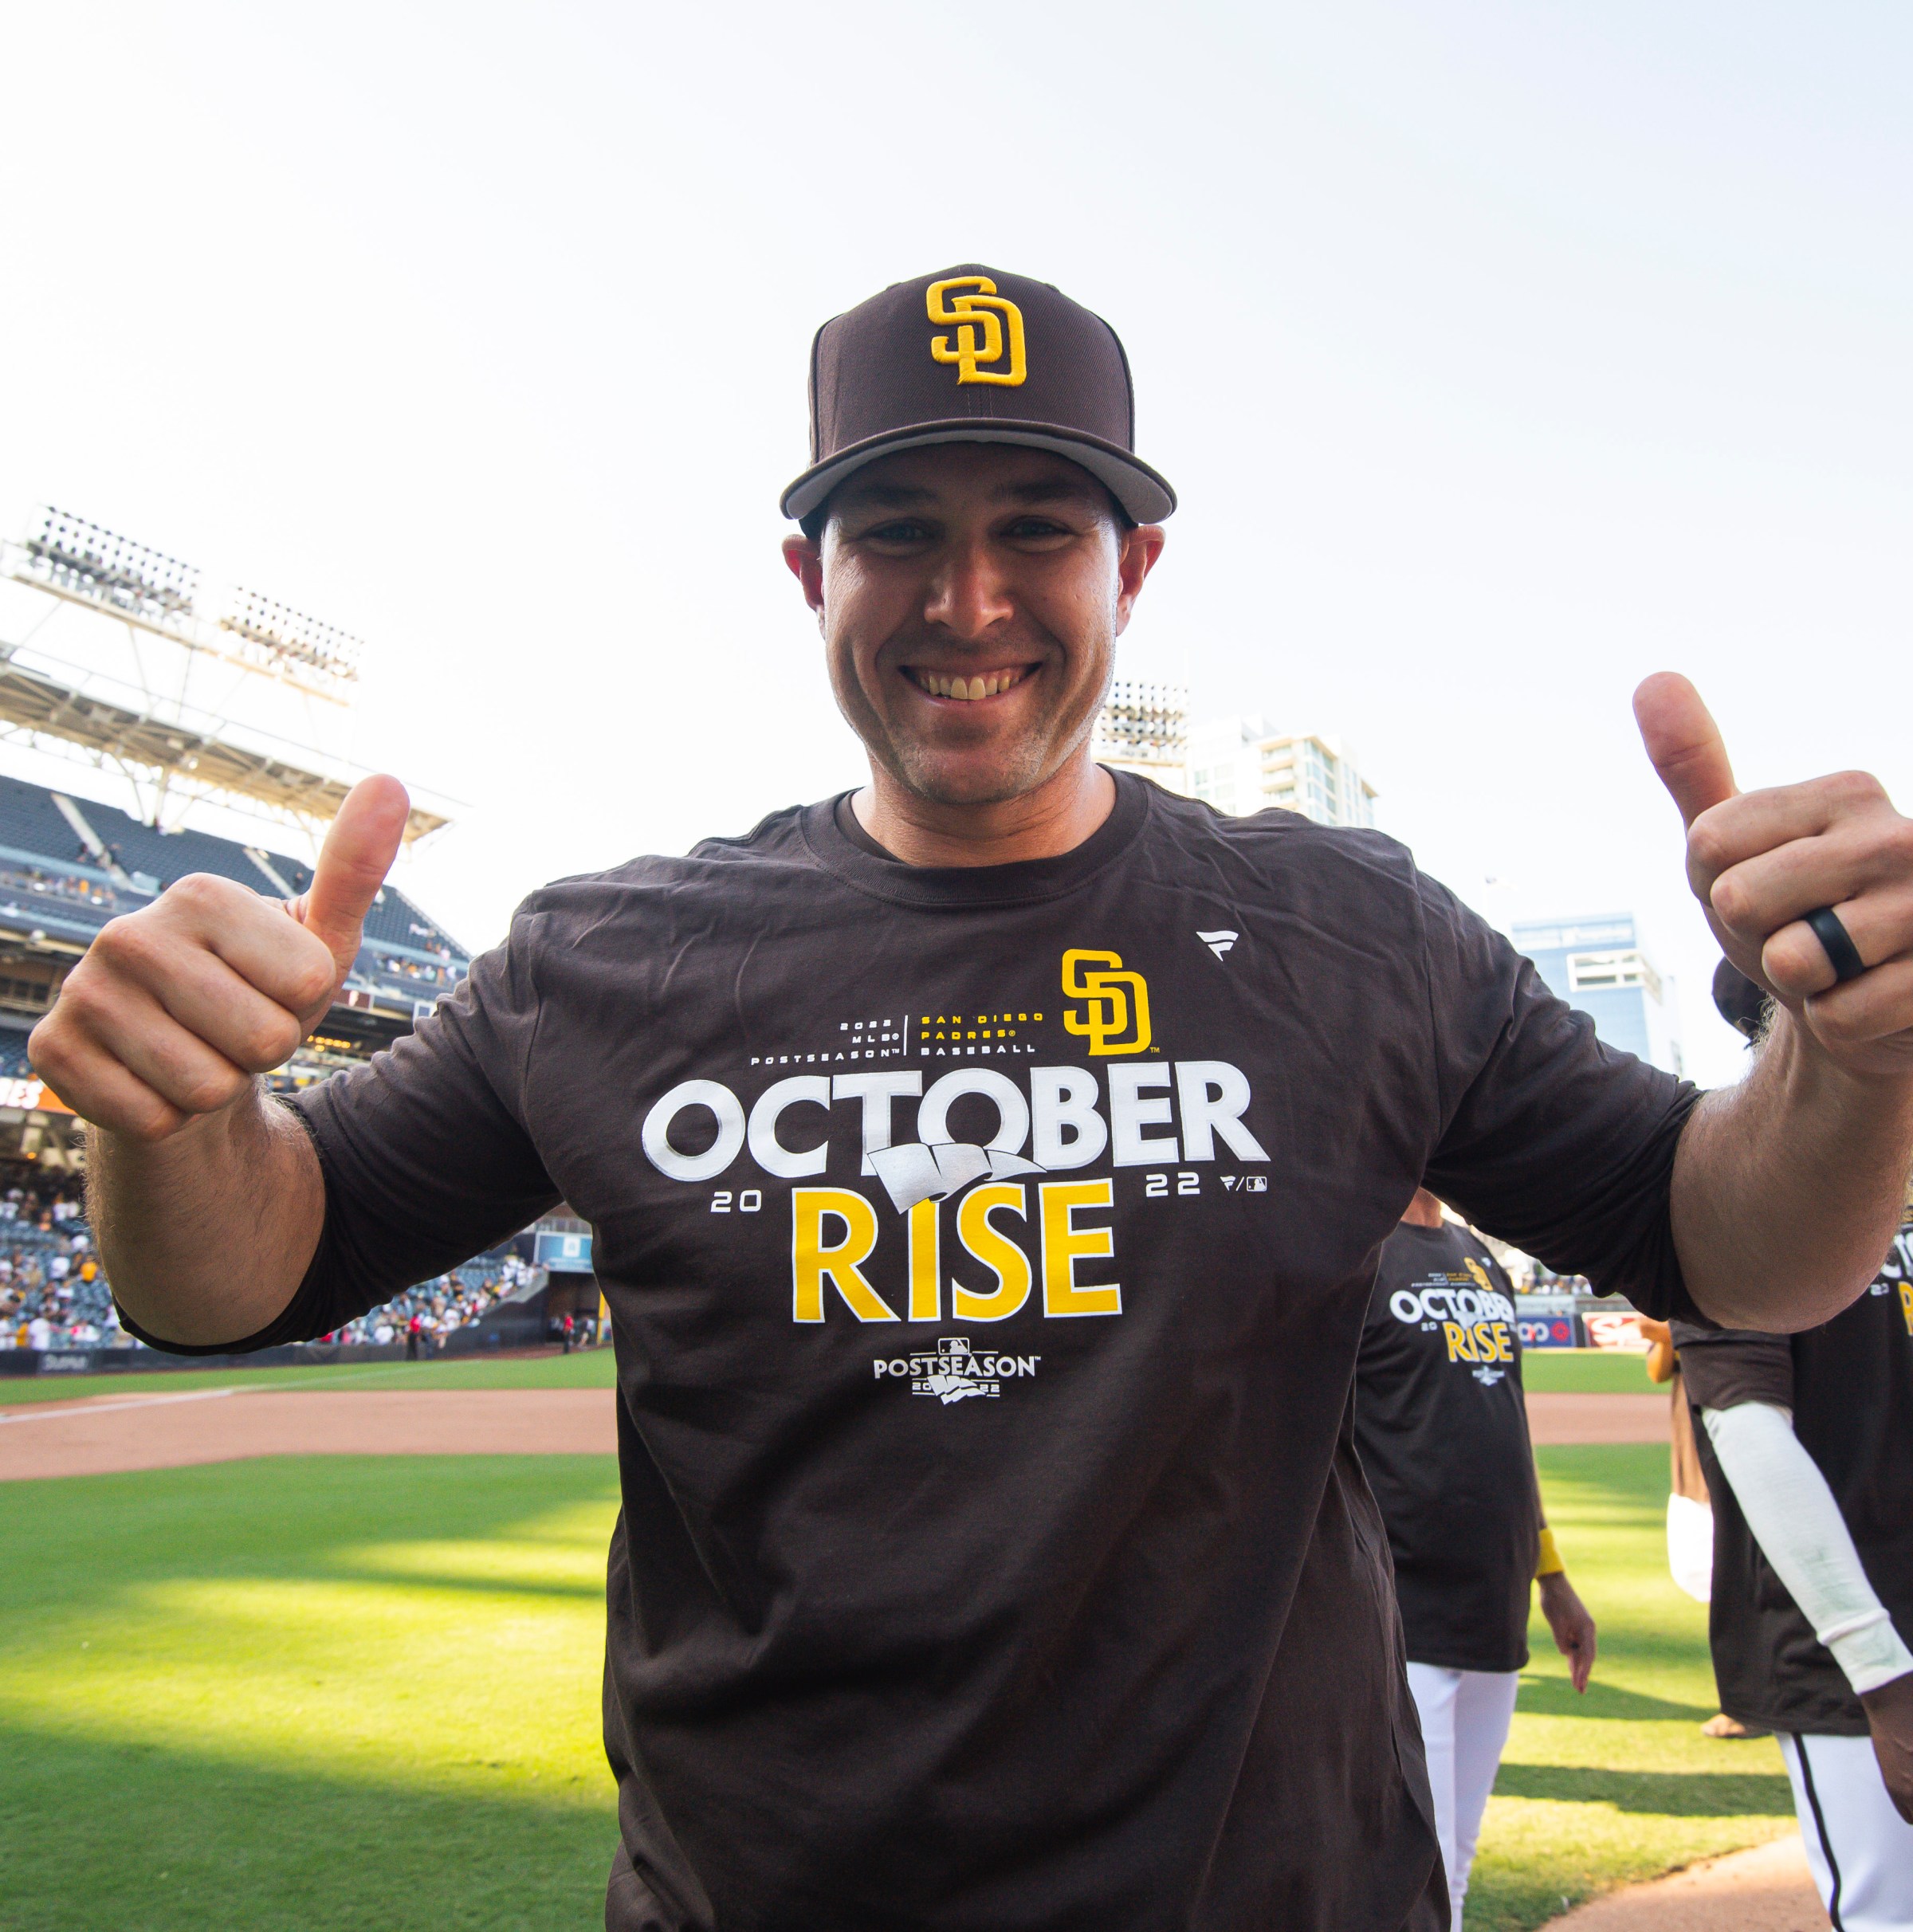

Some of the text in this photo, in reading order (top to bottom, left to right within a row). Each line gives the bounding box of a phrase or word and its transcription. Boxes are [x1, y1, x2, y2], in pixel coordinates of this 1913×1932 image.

[921, 1012, 1043, 1025] SAN DIEGO
[921, 1044, 1035, 1056] BASEBALL
[642, 1060, 1271, 1181] OCTOBER
[1145, 1172, 1201, 1198] 22
[710, 1189, 762, 1213] 20
[792, 1178, 1123, 1323] RISE
[1443, 1321, 1514, 1363] RISE
